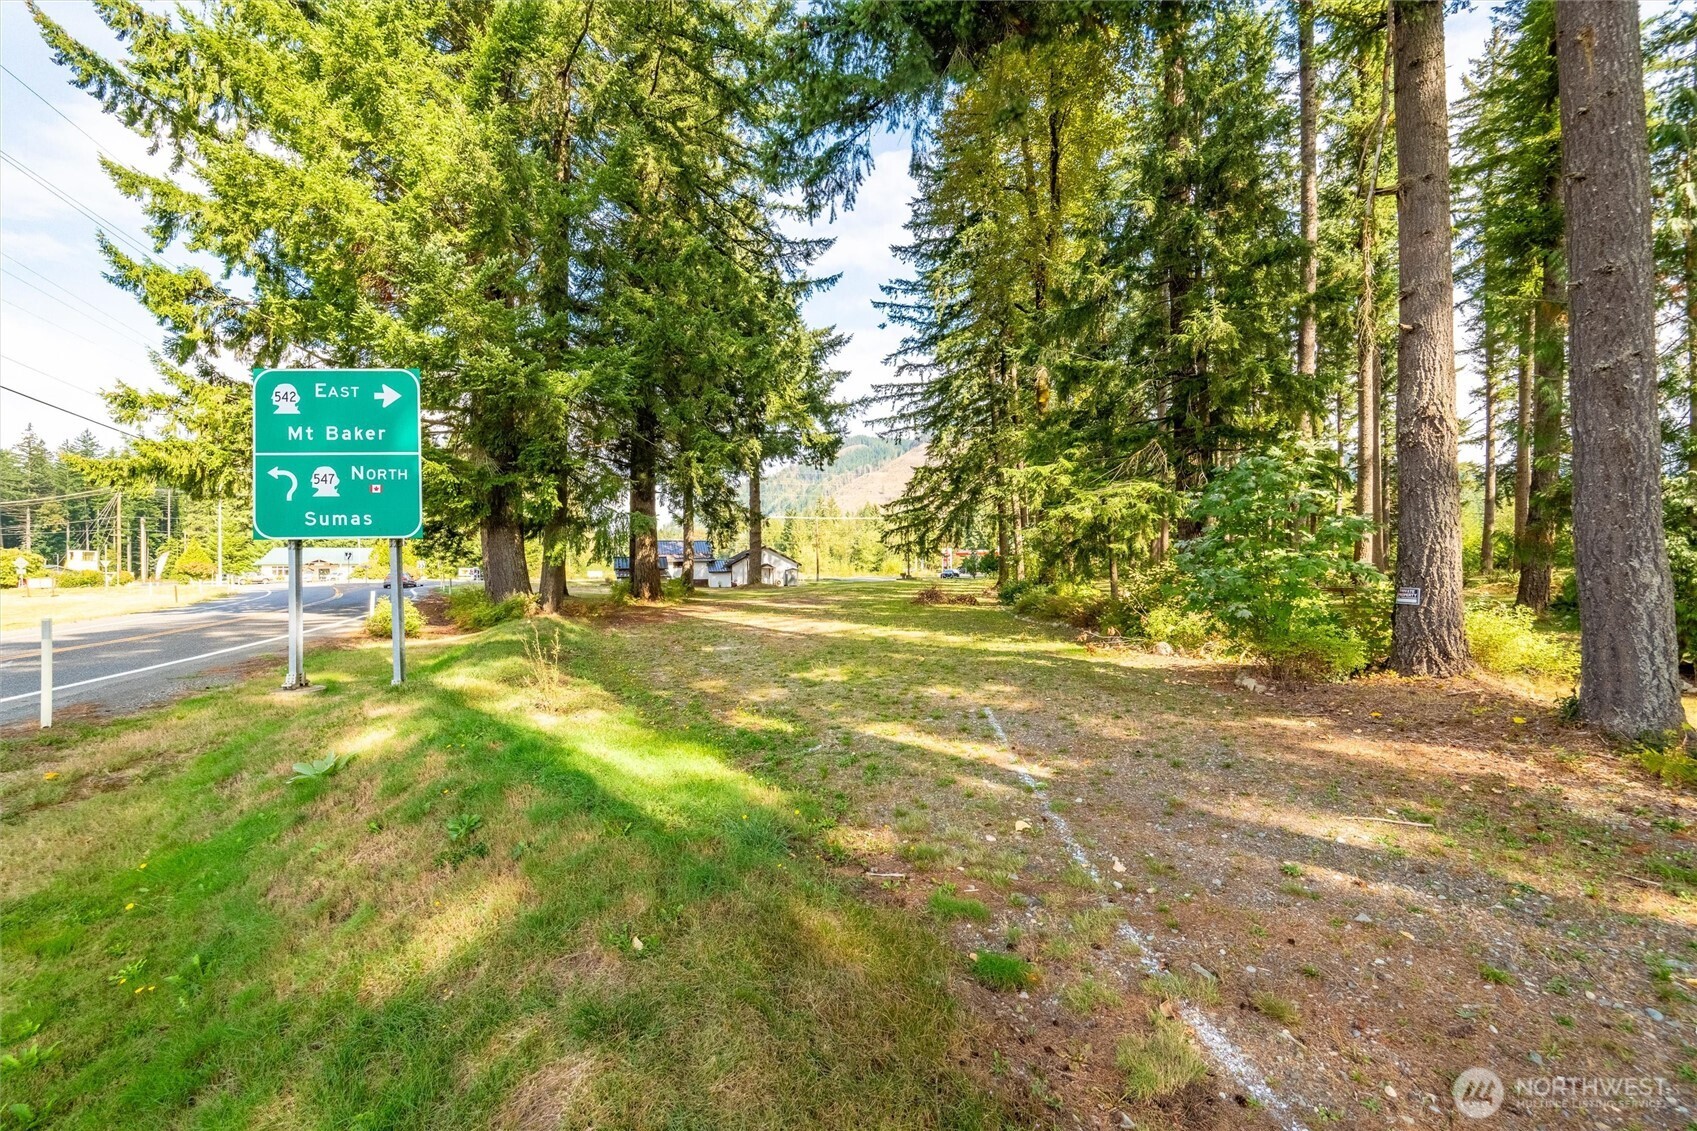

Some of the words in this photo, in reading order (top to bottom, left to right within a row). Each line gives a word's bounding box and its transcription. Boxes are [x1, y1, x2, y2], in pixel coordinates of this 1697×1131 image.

[274, 392, 297, 403] 542
[315, 383, 360, 398] EAST
[288, 426, 314, 441] Mt
[326, 426, 386, 441] Baker
[313, 473, 335, 485] 547
[351, 466, 408, 480] NORTH
[304, 511, 372, 526] Sumas
